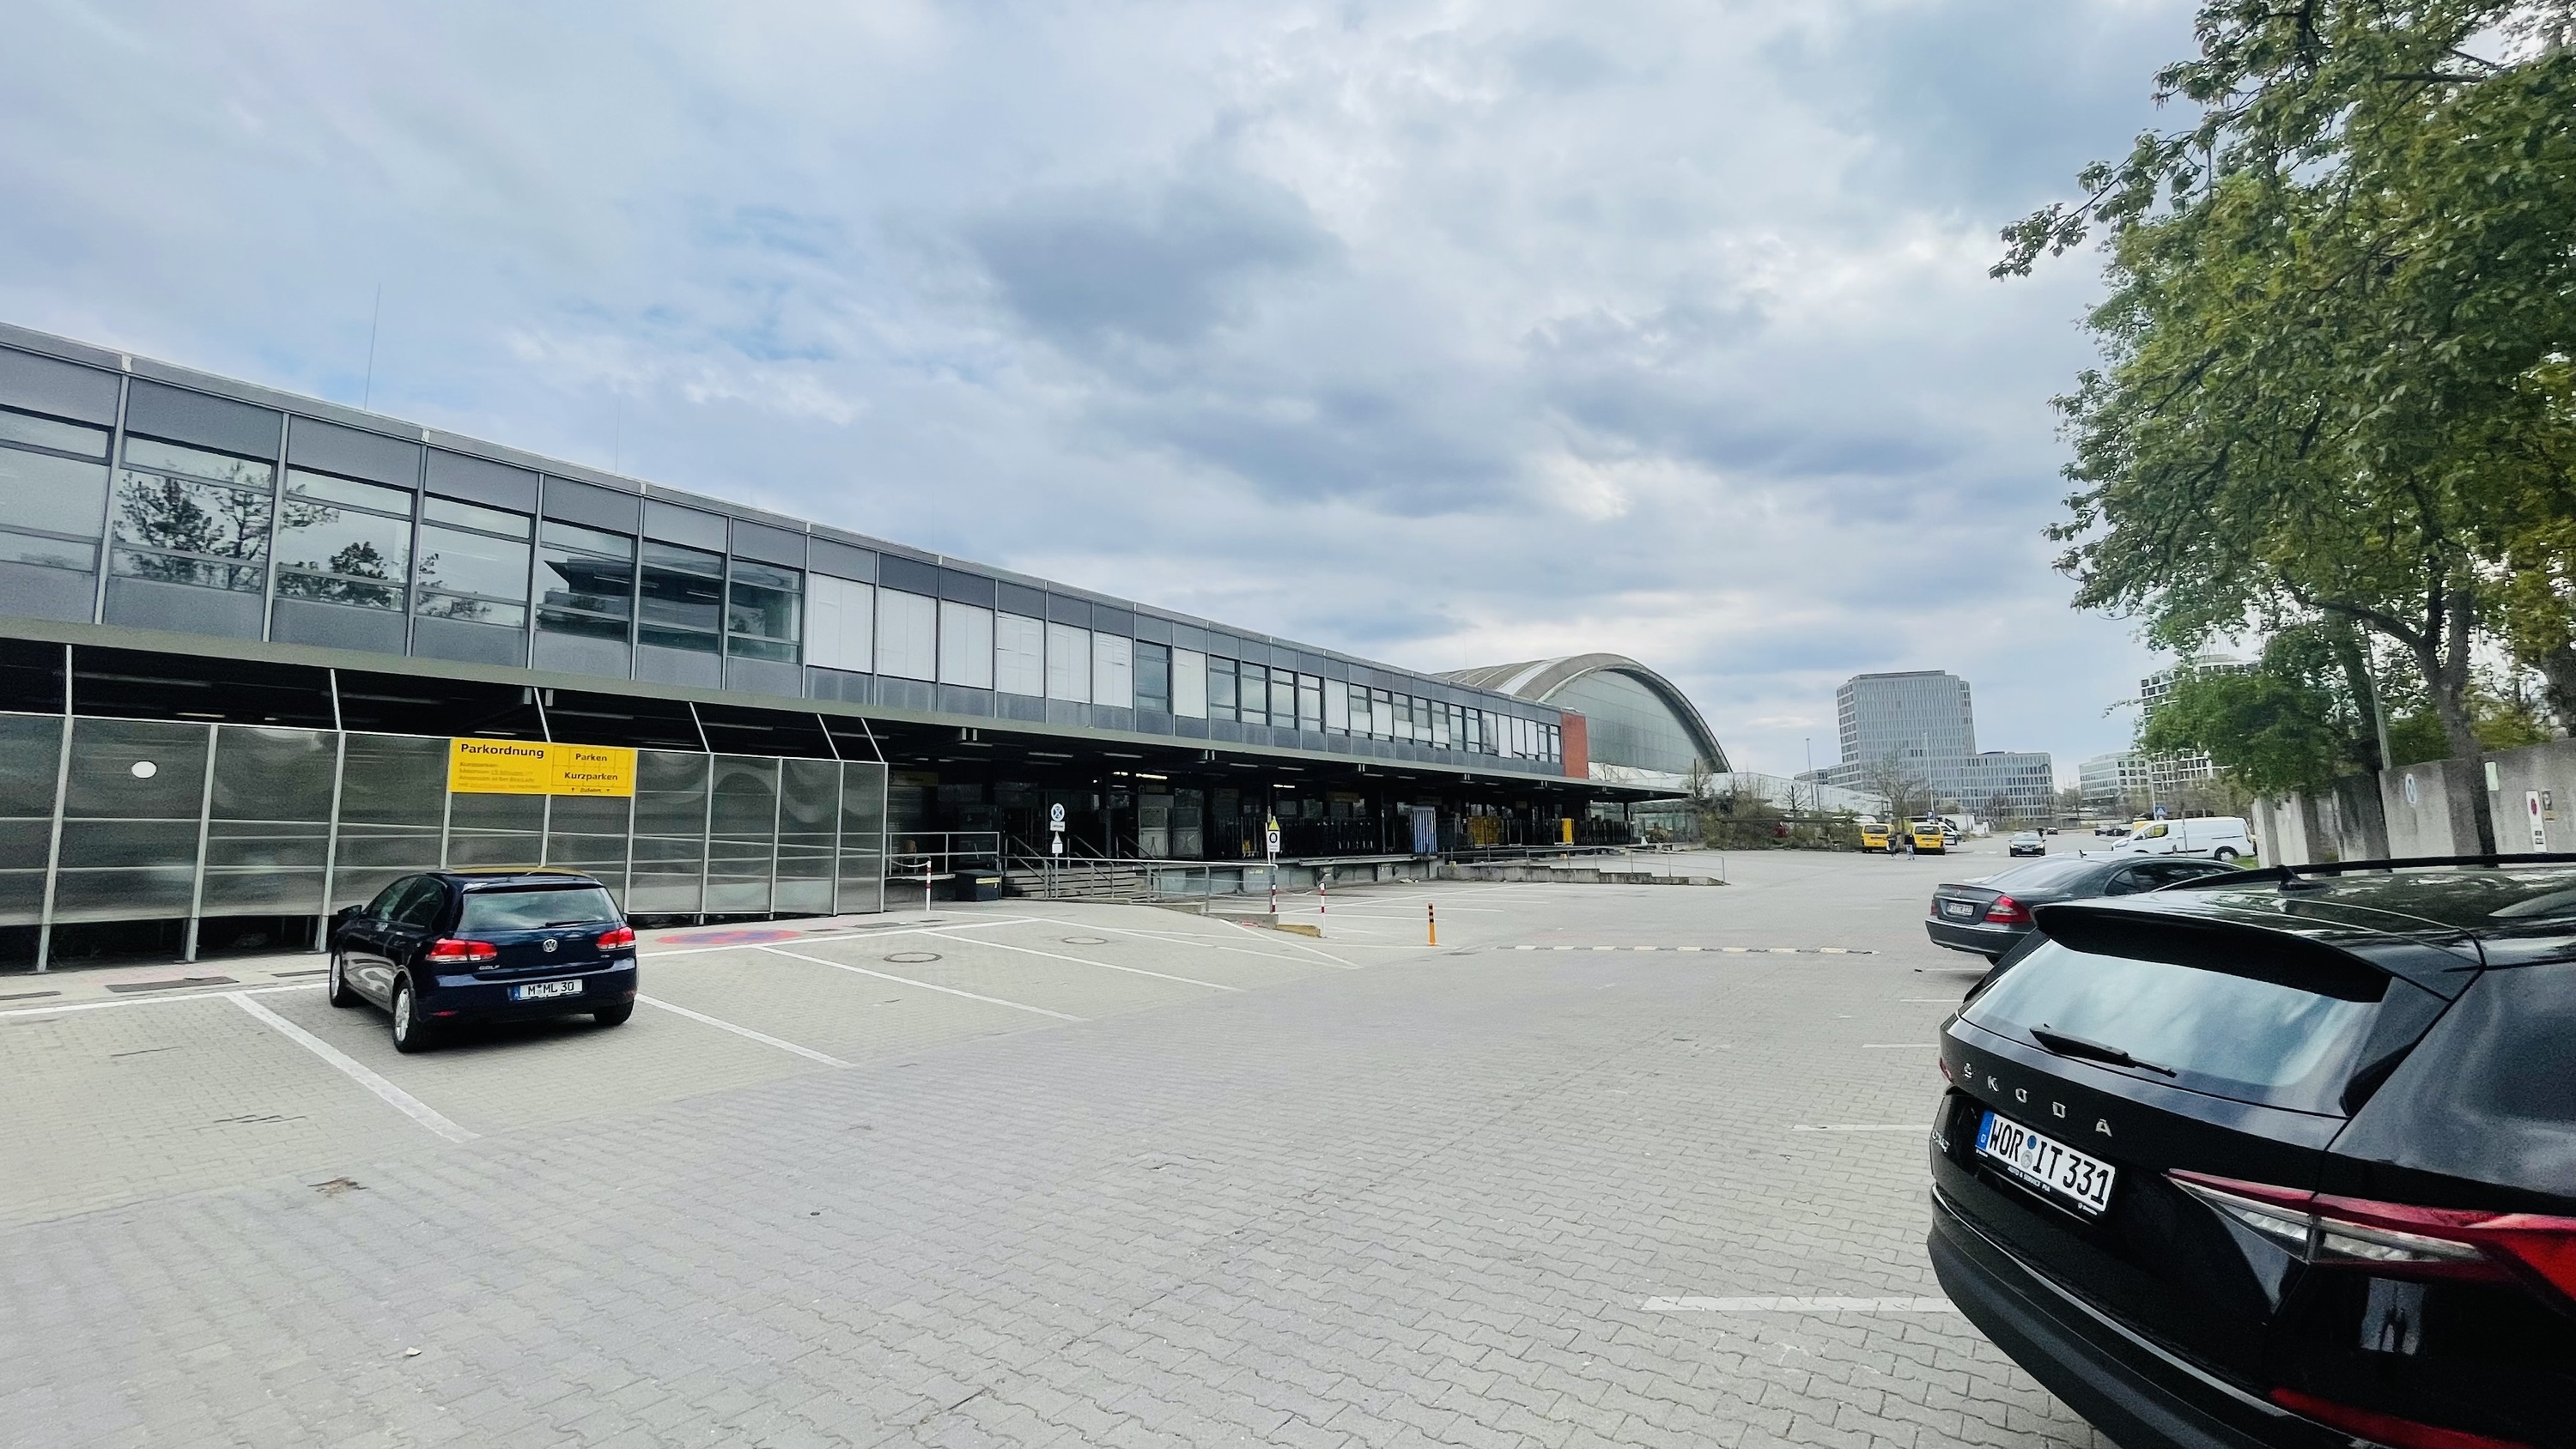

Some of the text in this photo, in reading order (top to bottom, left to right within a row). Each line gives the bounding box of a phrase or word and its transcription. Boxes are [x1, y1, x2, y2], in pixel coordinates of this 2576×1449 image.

[461, 743, 544, 759] Parkordnung
[575, 753, 607, 761] Parken
[564, 772, 618, 781] Kurzparken
[528, 982, 574, 995] M ML 30
[1990, 1119, 2110, 1205] WOR IT 331
